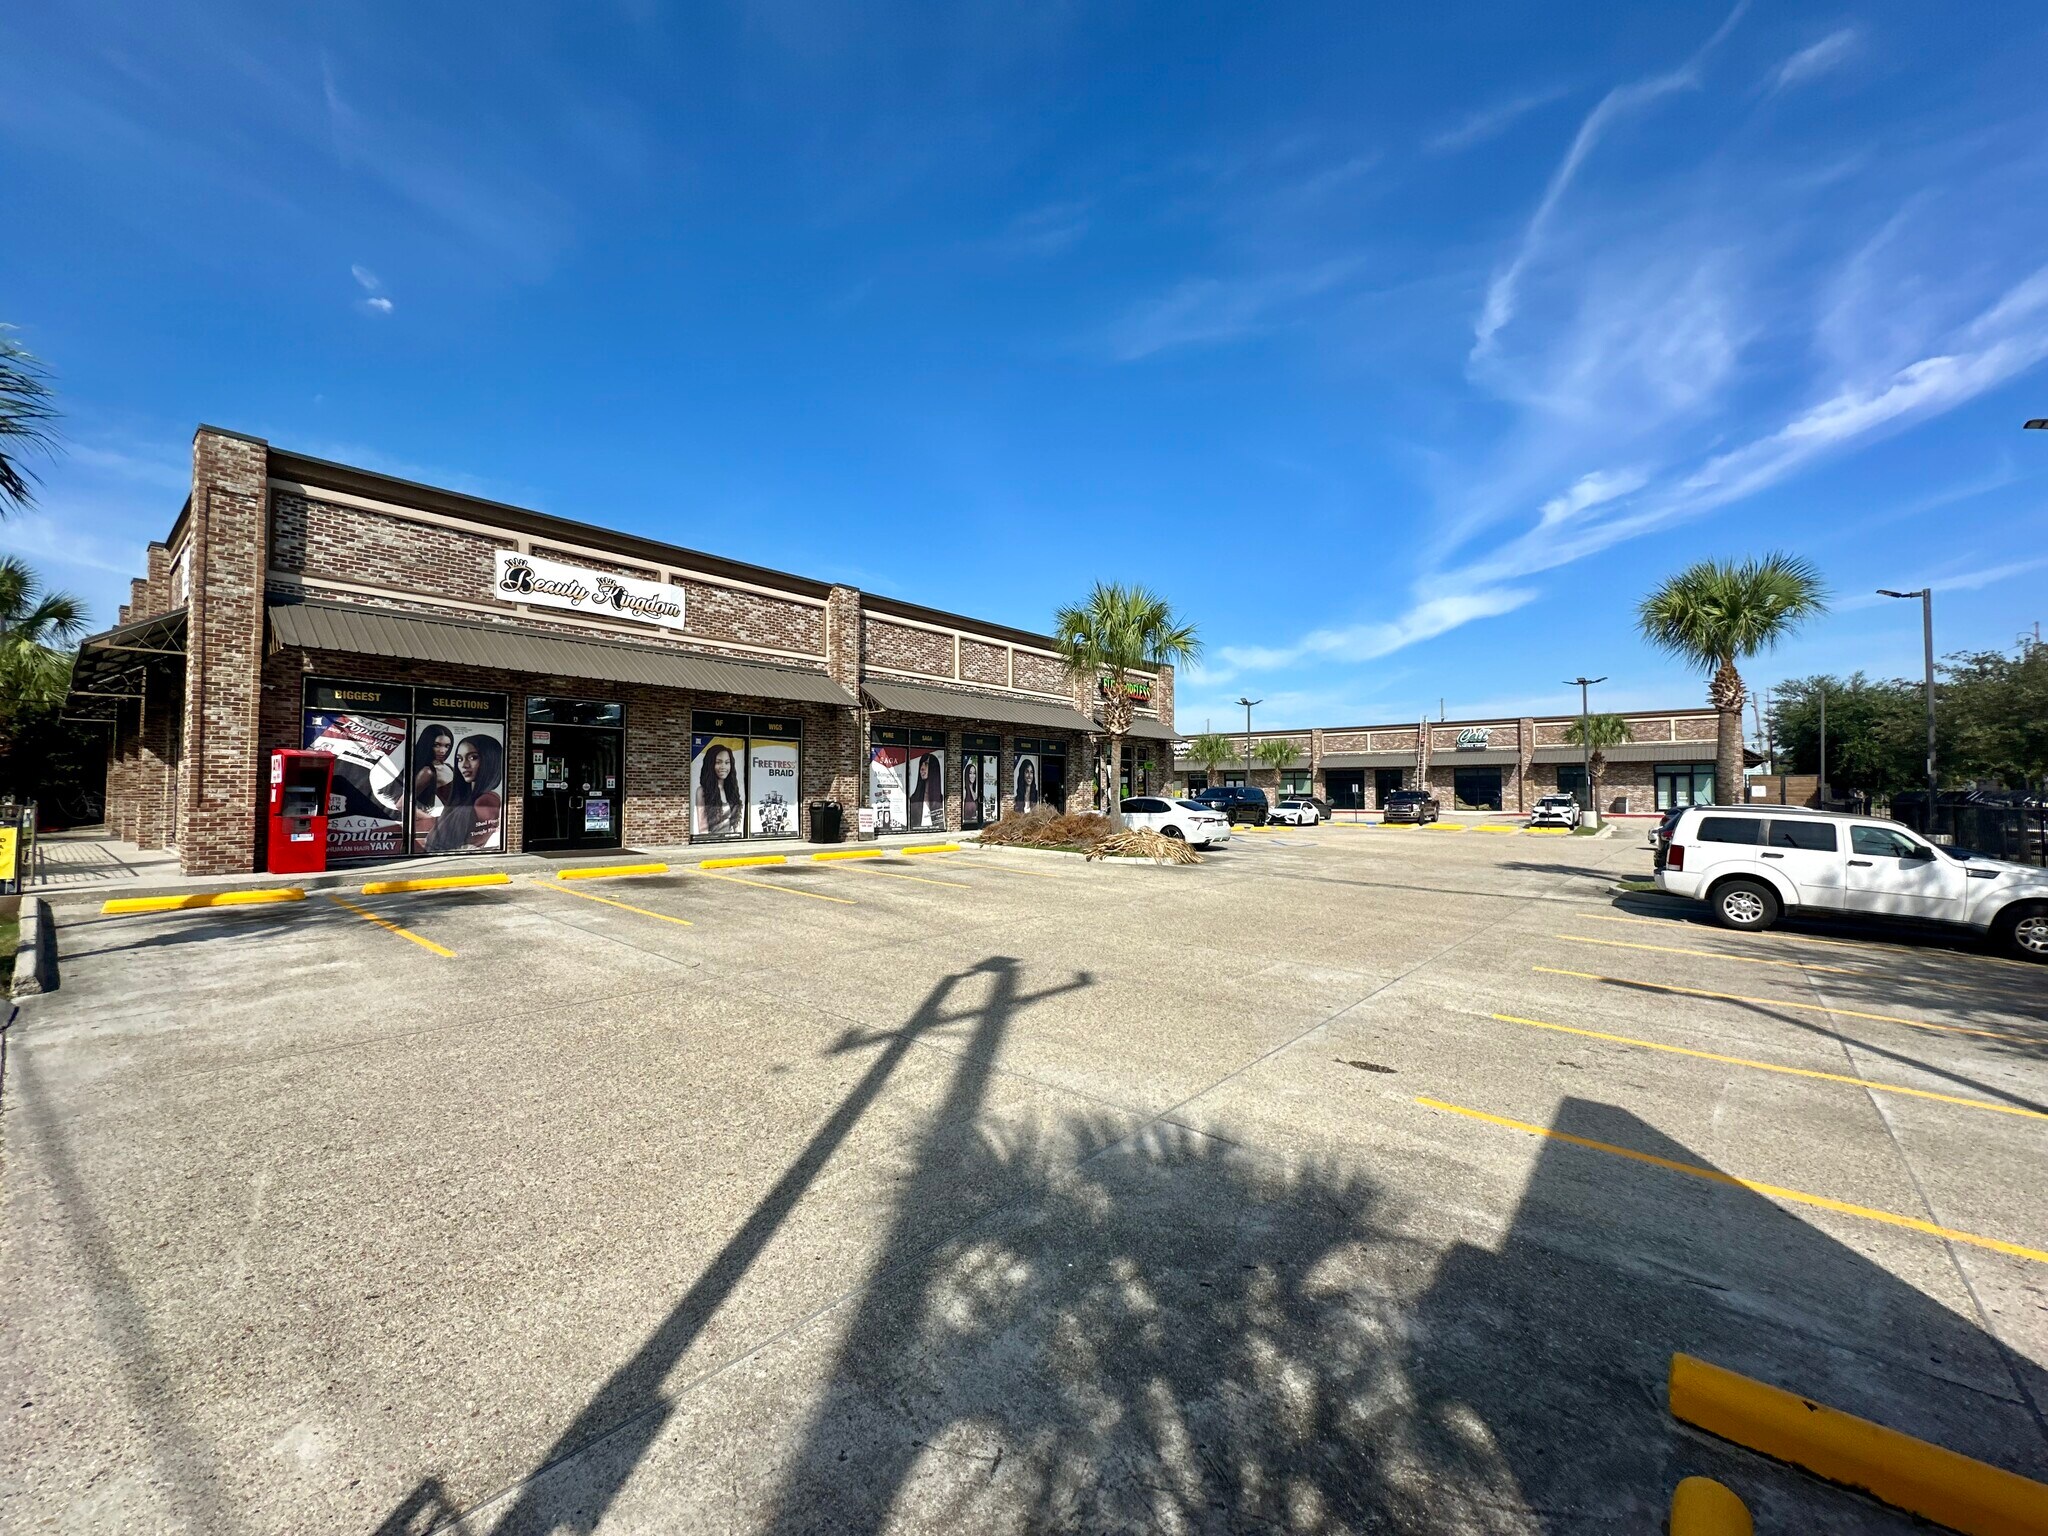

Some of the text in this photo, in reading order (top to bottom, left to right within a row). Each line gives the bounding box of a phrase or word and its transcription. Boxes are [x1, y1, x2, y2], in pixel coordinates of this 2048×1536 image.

[500, 564, 681, 619] Beauty Kingdom
[335, 690, 489, 709] BIGGEST SELECTIONS
[342, 720, 397, 742] Popular
[360, 718, 390, 732] SAGA
[715, 719, 783, 731] OF WIGS
[373, 738, 397, 752] YAKY
[879, 756, 898, 764] SAGA
[769, 769, 794, 777] BRAID
[331, 819, 379, 828] SAGA
[327, 828, 393, 846] opular
[369, 841, 396, 851] YAKY
